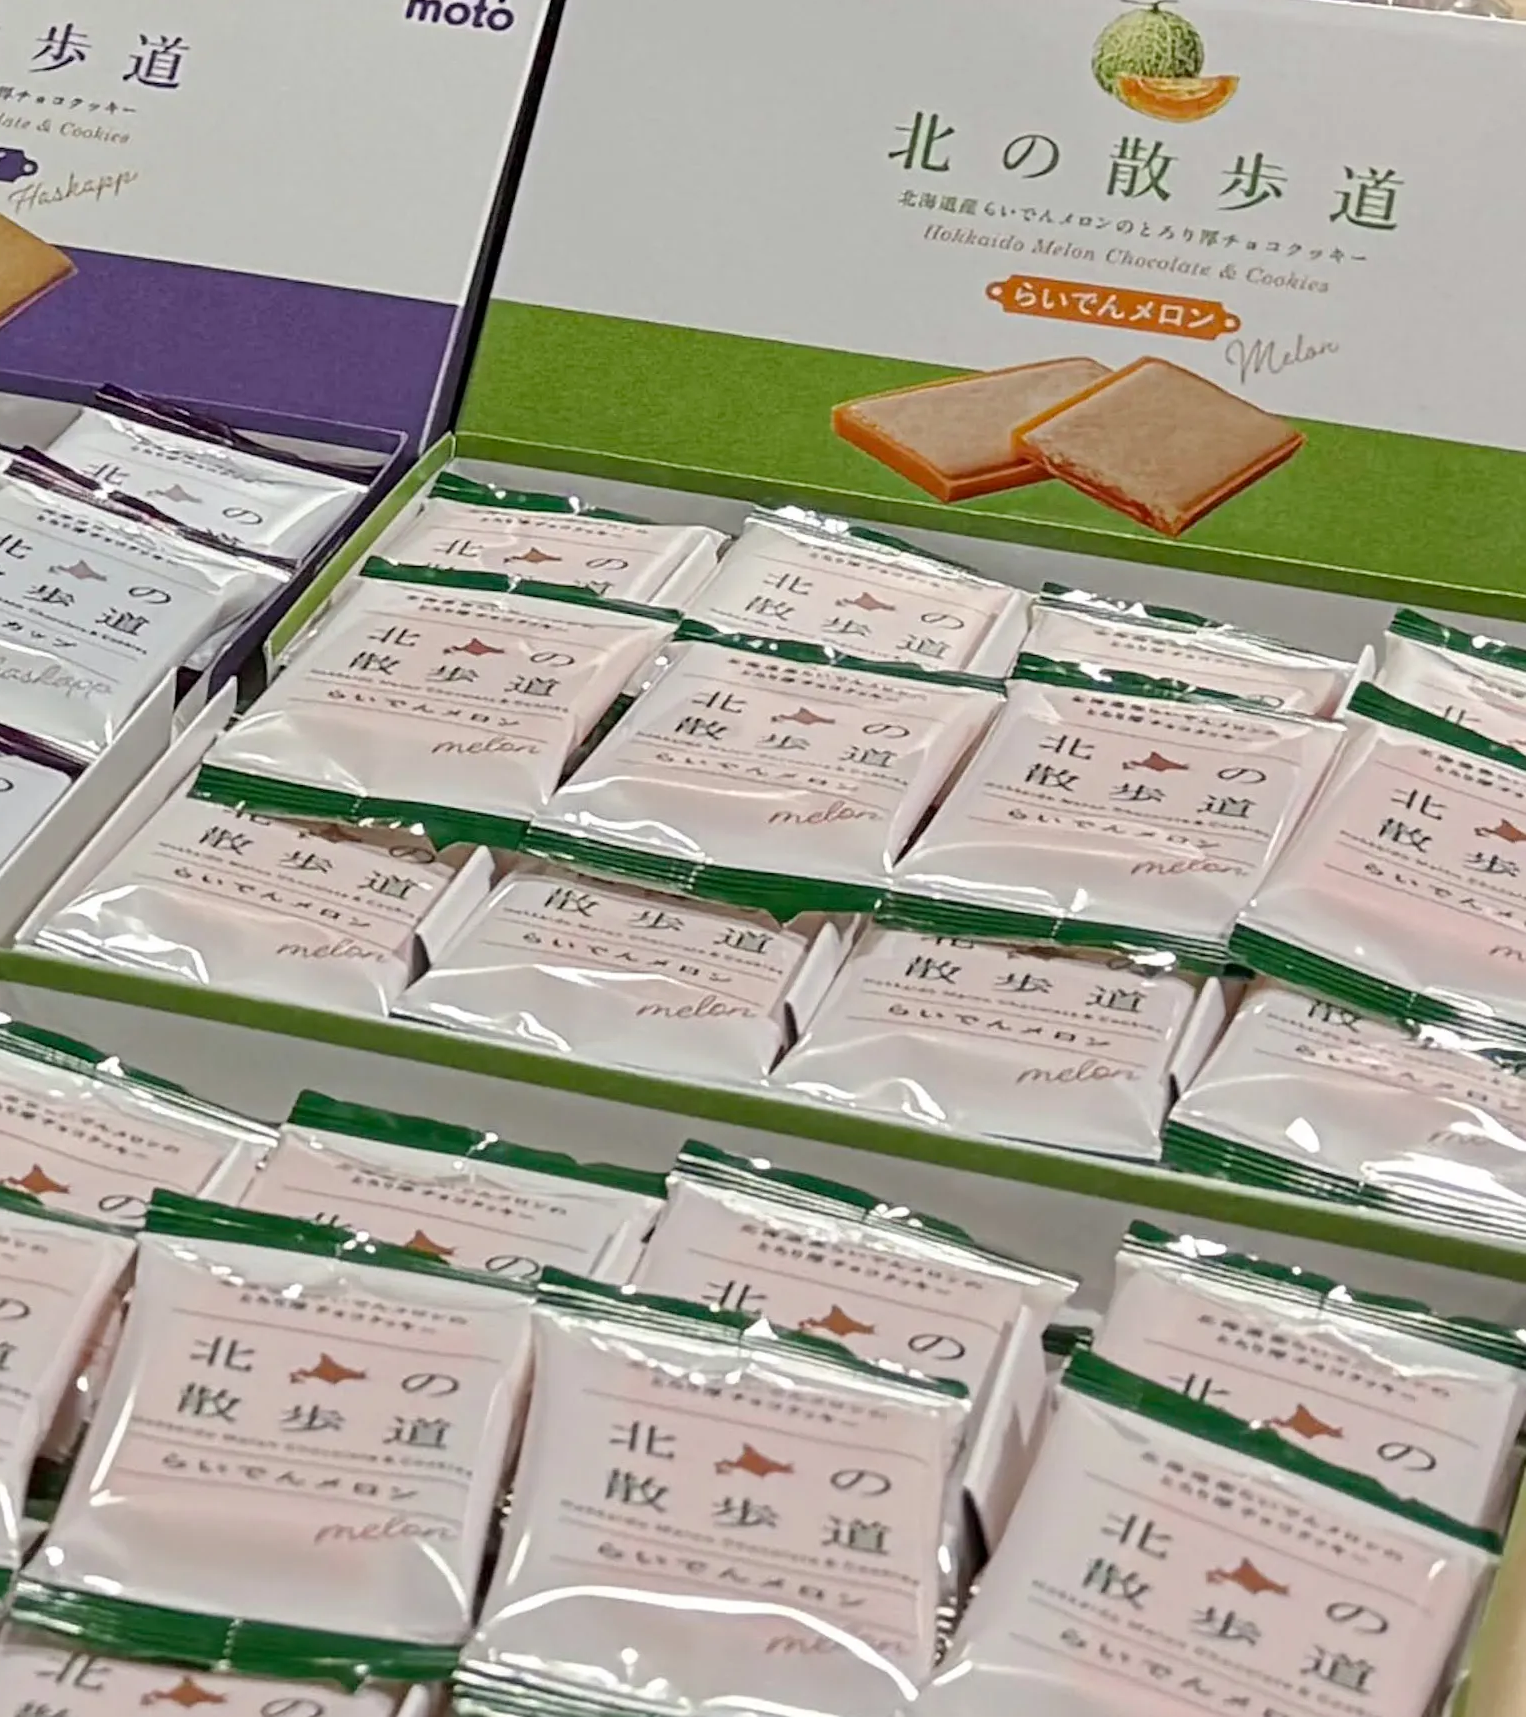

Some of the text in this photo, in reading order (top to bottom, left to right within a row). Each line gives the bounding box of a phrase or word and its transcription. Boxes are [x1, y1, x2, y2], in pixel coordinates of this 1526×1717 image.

[36, 118, 51, 134] &
[57, 120, 131, 145] Cookies
[7, 167, 139, 214] Haskapp
[887, 110, 1406, 233] 北の散歩道
[922, 222, 1330, 296] Hokkaido Melon Chocolate & Cookies
[1012, 282, 1218, 334] らいでんメロン
[1224, 337, 1340, 384] Melon
[744, 593, 951, 662] 散歩道
[348, 650, 558, 700] 散歩道
[430, 733, 541, 758] melon
[672, 714, 898, 771] 散歩道
[768, 799, 887, 829] melon
[1023, 757, 1257, 821] 散歩道
[199, 824, 420, 905] 散歩道
[1129, 854, 1247, 881] melon
[543, 885, 776, 955] 散歩道
[276, 938, 389, 964] melon
[636, 995, 759, 1024] melon
[903, 955, 1148, 1015] 散歩道
[888, 1000, 1114, 1049] らいでんメロン
[1016, 1058, 1146, 1085] melon
[176, 1381, 449, 1451] 散歩道
[160, 1449, 419, 1503] らいでんメロン
[313, 1514, 460, 1545] melon
[604, 1467, 892, 1556] 散歩道
[596, 1540, 870, 1610] らいでんメロン
[1081, 1556, 1377, 1696] 散歩道
